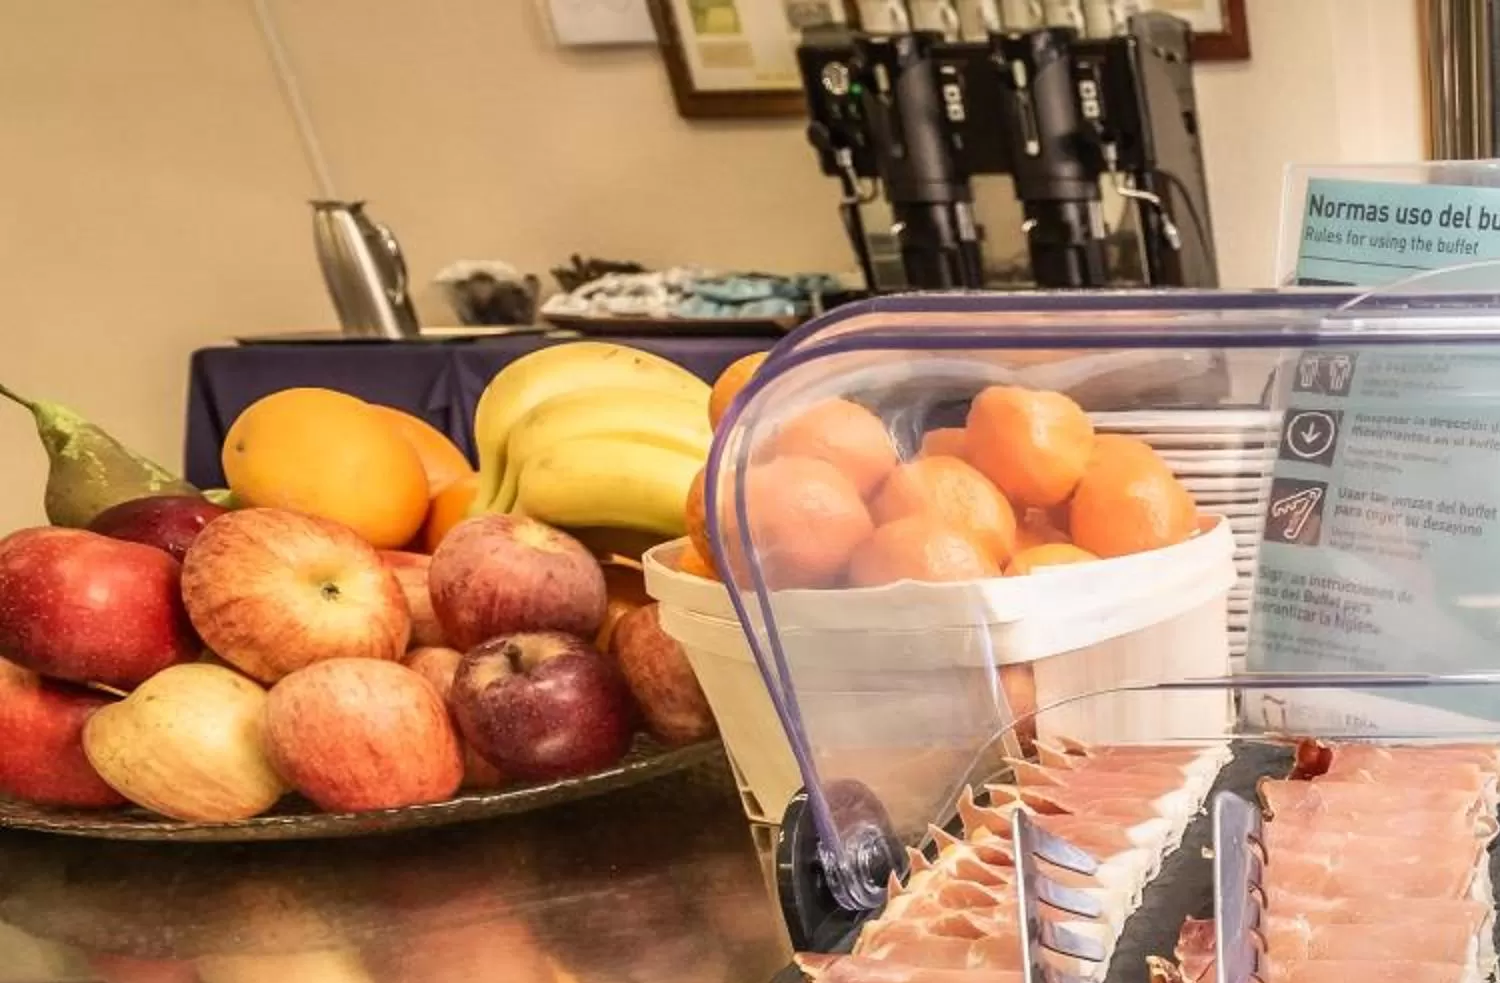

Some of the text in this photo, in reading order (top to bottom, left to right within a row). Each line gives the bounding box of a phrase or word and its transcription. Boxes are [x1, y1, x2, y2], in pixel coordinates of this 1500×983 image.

[1308, 194, 1390, 223] Normas
[1395, 205, 1433, 226] uso
[1439, 203, 1472, 229] del
[1305, 226, 1479, 256] Rules for using the buffet
[1436, 499, 1457, 515] del
[1459, 501, 1499, 521] buffet
[1423, 515, 1483, 537] desayuno
